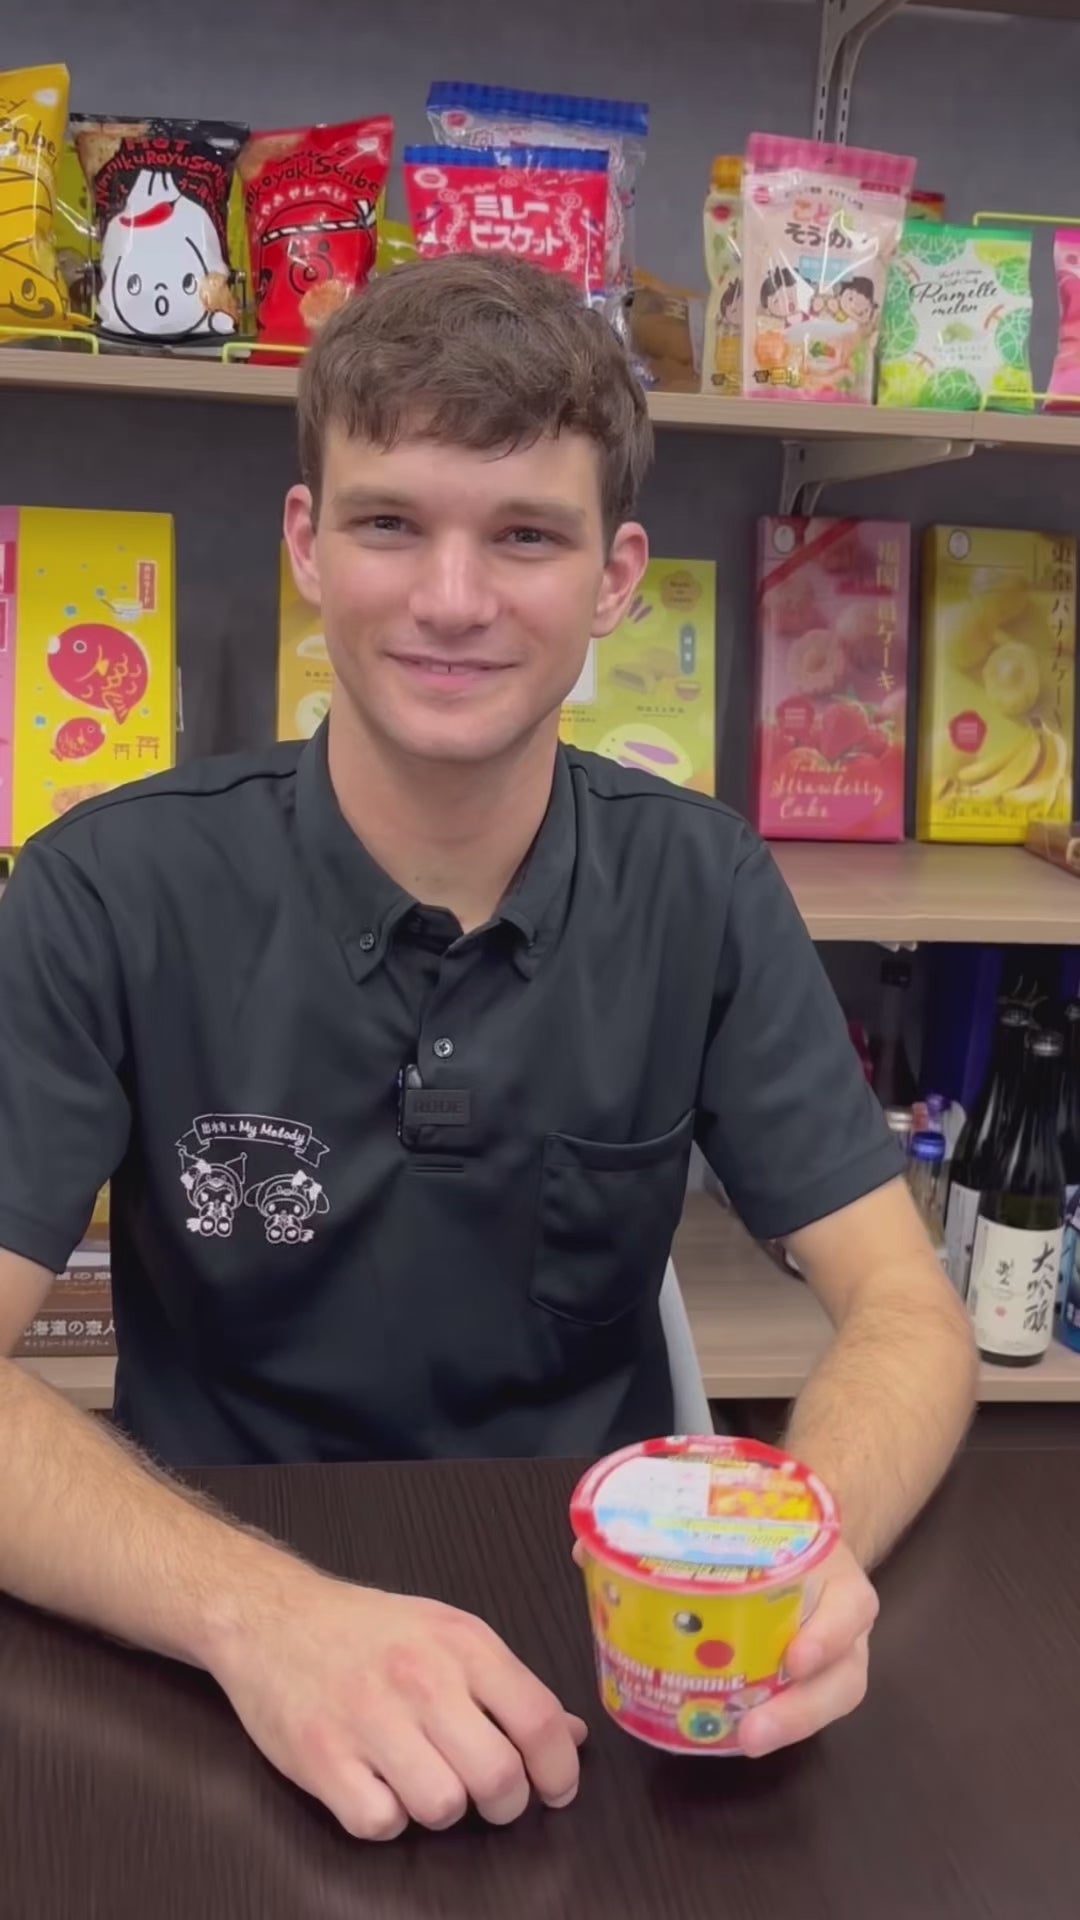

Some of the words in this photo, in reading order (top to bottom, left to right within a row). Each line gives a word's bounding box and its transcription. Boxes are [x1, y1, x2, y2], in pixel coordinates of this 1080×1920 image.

[474, 194, 549, 220] ミレー
[470, 220, 563, 256] ビスケット
[239, 1120, 257, 1138] My
[260, 1123, 305, 1146] Melody
